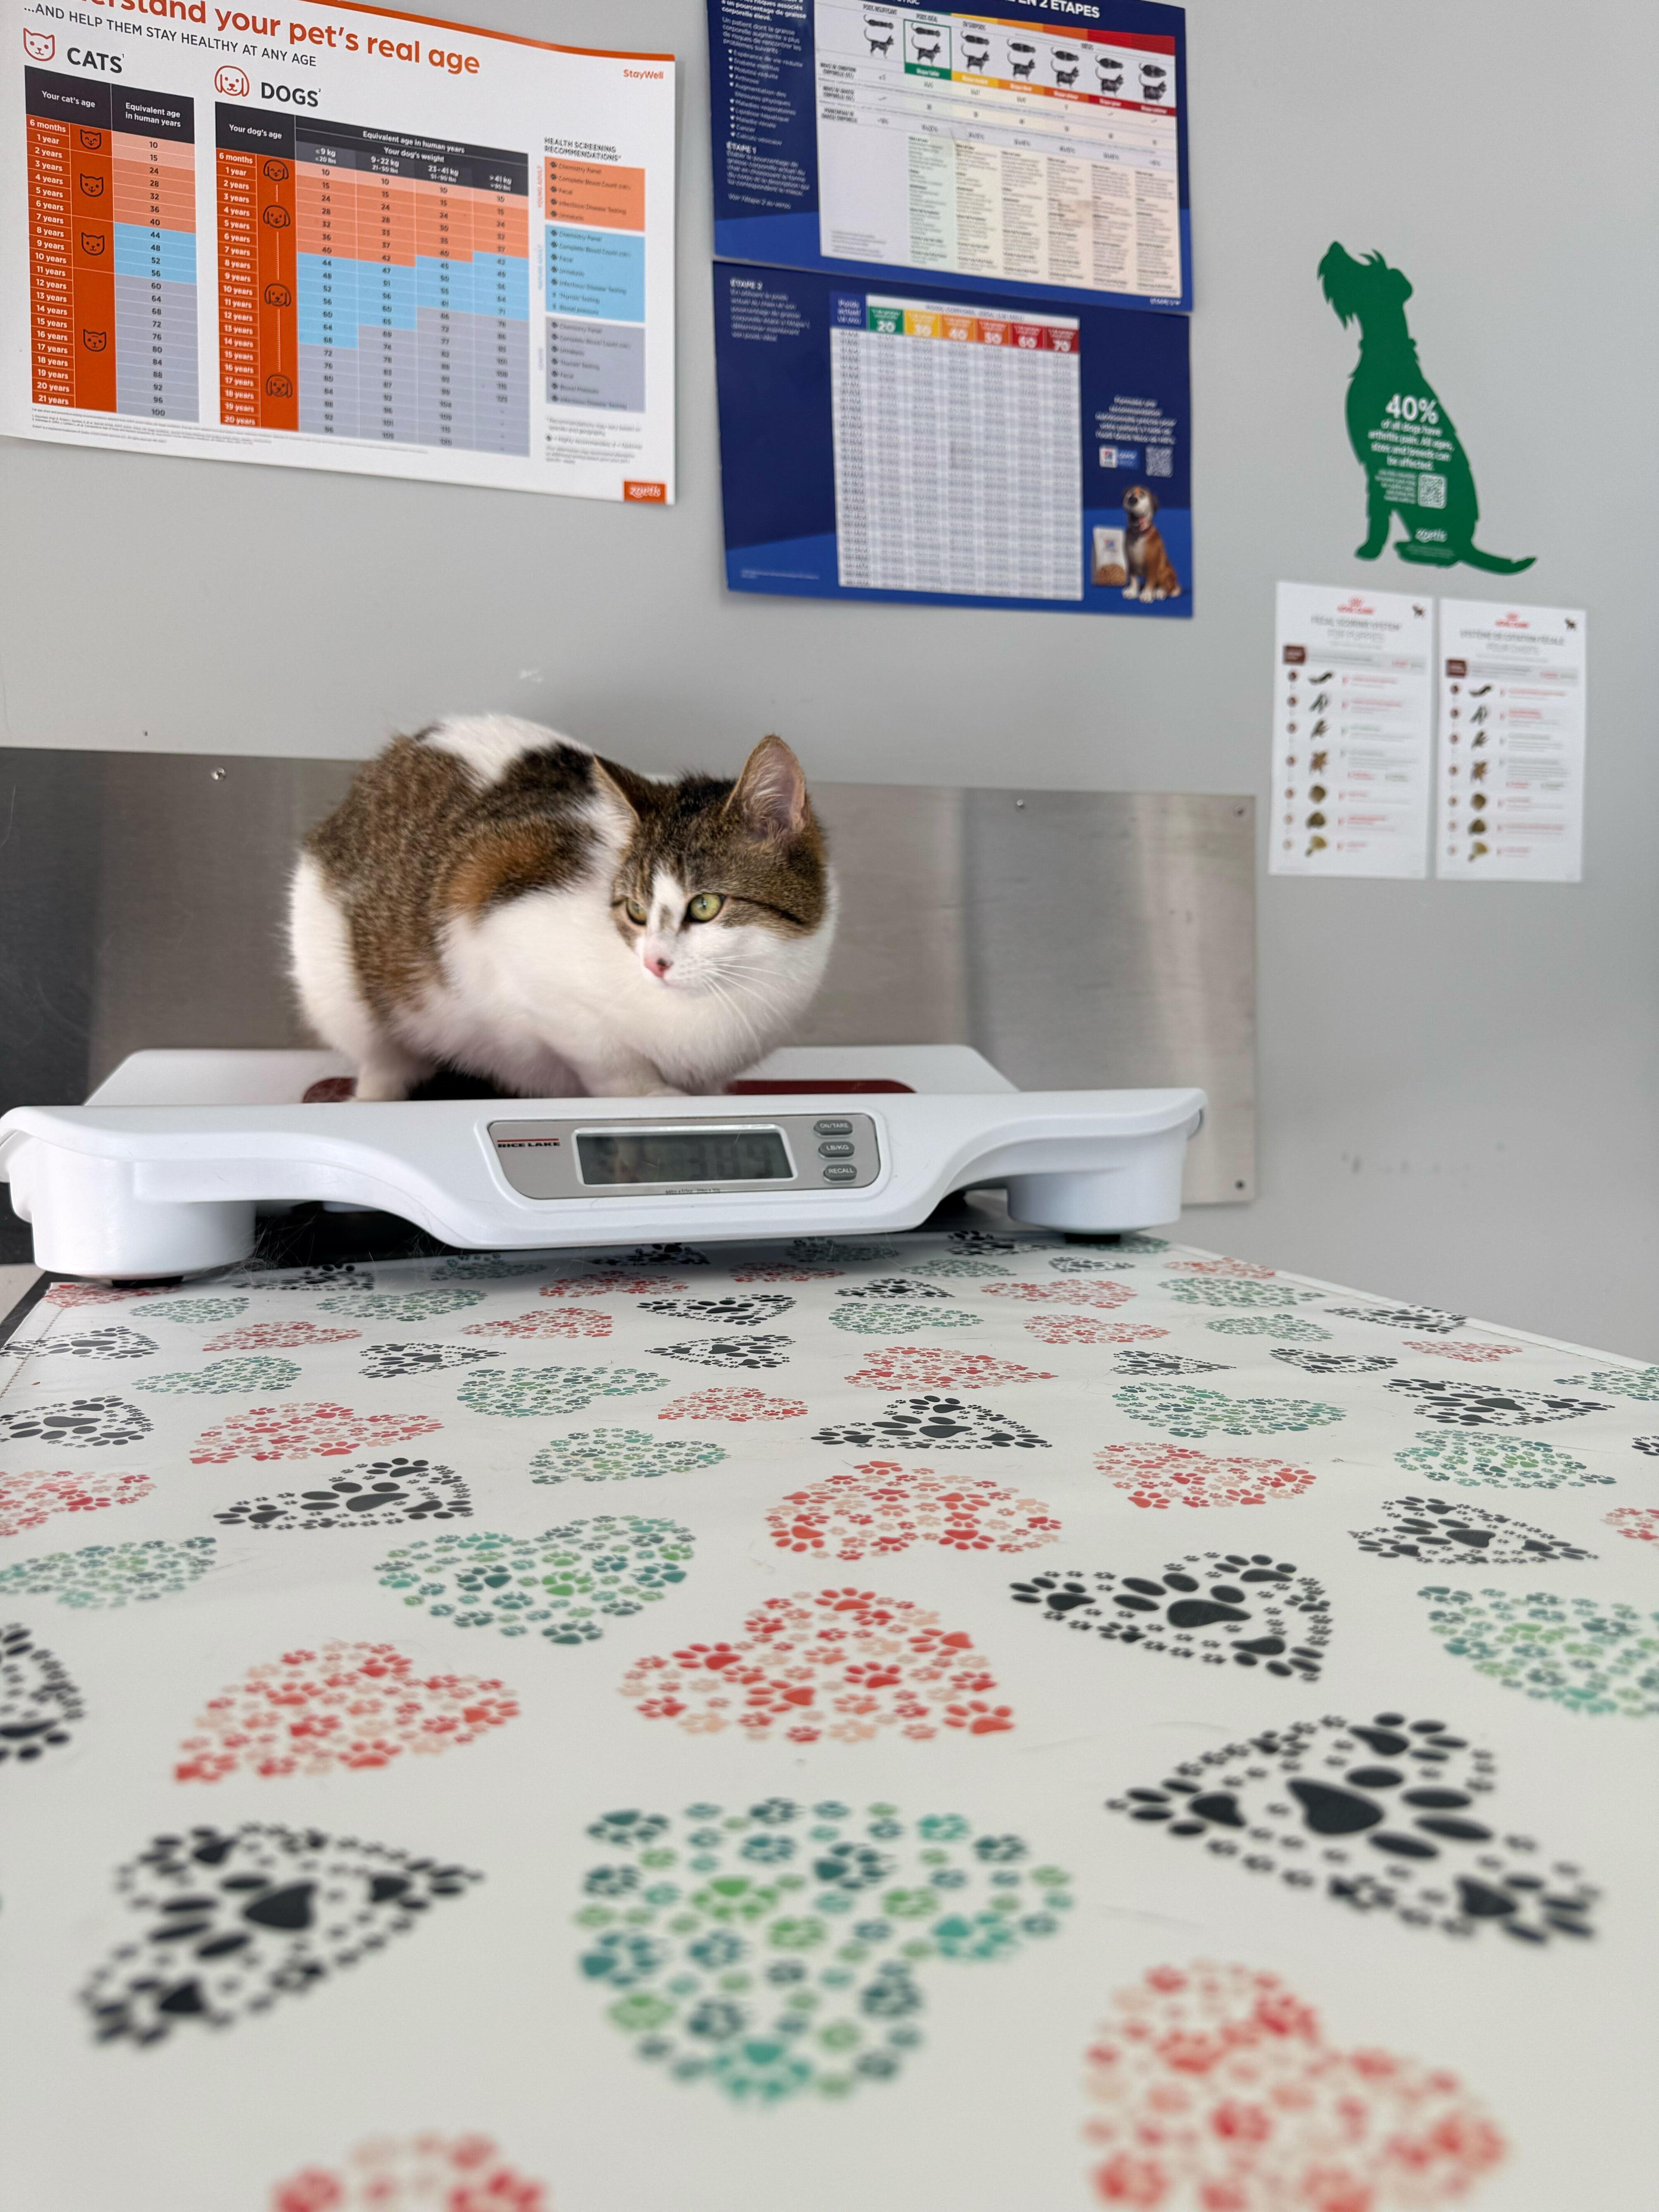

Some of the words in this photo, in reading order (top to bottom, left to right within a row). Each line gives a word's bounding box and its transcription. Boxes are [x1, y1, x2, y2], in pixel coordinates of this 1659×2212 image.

[24, 4, 64, 19] ...AND
[70, 11, 102, 27] HELP
[106, 19, 141, 35] THEM
[147, 27, 177, 41] STAY
[182, 33, 238, 52] HEALTHY
[243, 45, 257, 55] AT
[262, 48, 287, 61] ANY
[292, 53, 316, 66] AGE
[216, 9, 280, 36] your
[290, 23, 359, 51] pet's
[368, 37, 419, 63] real
[429, 49, 480, 74] age
[623, 69, 664, 80] StayWell
[42, 91, 59, 100] Your
[125, 102, 165, 115] Equivalent
[134, 113, 159, 124] human
[37, 122, 66, 132] months
[229, 124, 246, 132] Your
[247, 127, 267, 137] dog's
[42, 136, 59, 144] year
[363, 131, 399, 143] Equivalent
[400, 137, 413, 146] age
[422, 140, 445, 150] human
[446, 145, 465, 153] years
[41, 149, 62, 158] years
[383, 146, 400, 155] Your
[400, 149, 420, 159] dog's
[421, 153, 444, 163] weight
[226, 155, 252, 164] months
[42, 163, 63, 172] years
[43, 176, 63, 185] years
[43, 189, 63, 198] years
[43, 203, 64, 211] years
[43, 216, 64, 224] years
[43, 229, 64, 237] years
[44, 242, 64, 250] years
[46, 255, 67, 263] years
[45, 268, 65, 276] years
[46, 294, 67, 302] years
[876, 320, 896, 333] 20
[950, 328, 967, 341] 40
[1053, 340, 1071, 352] 70
[1385, 393, 1439, 424] 40%
